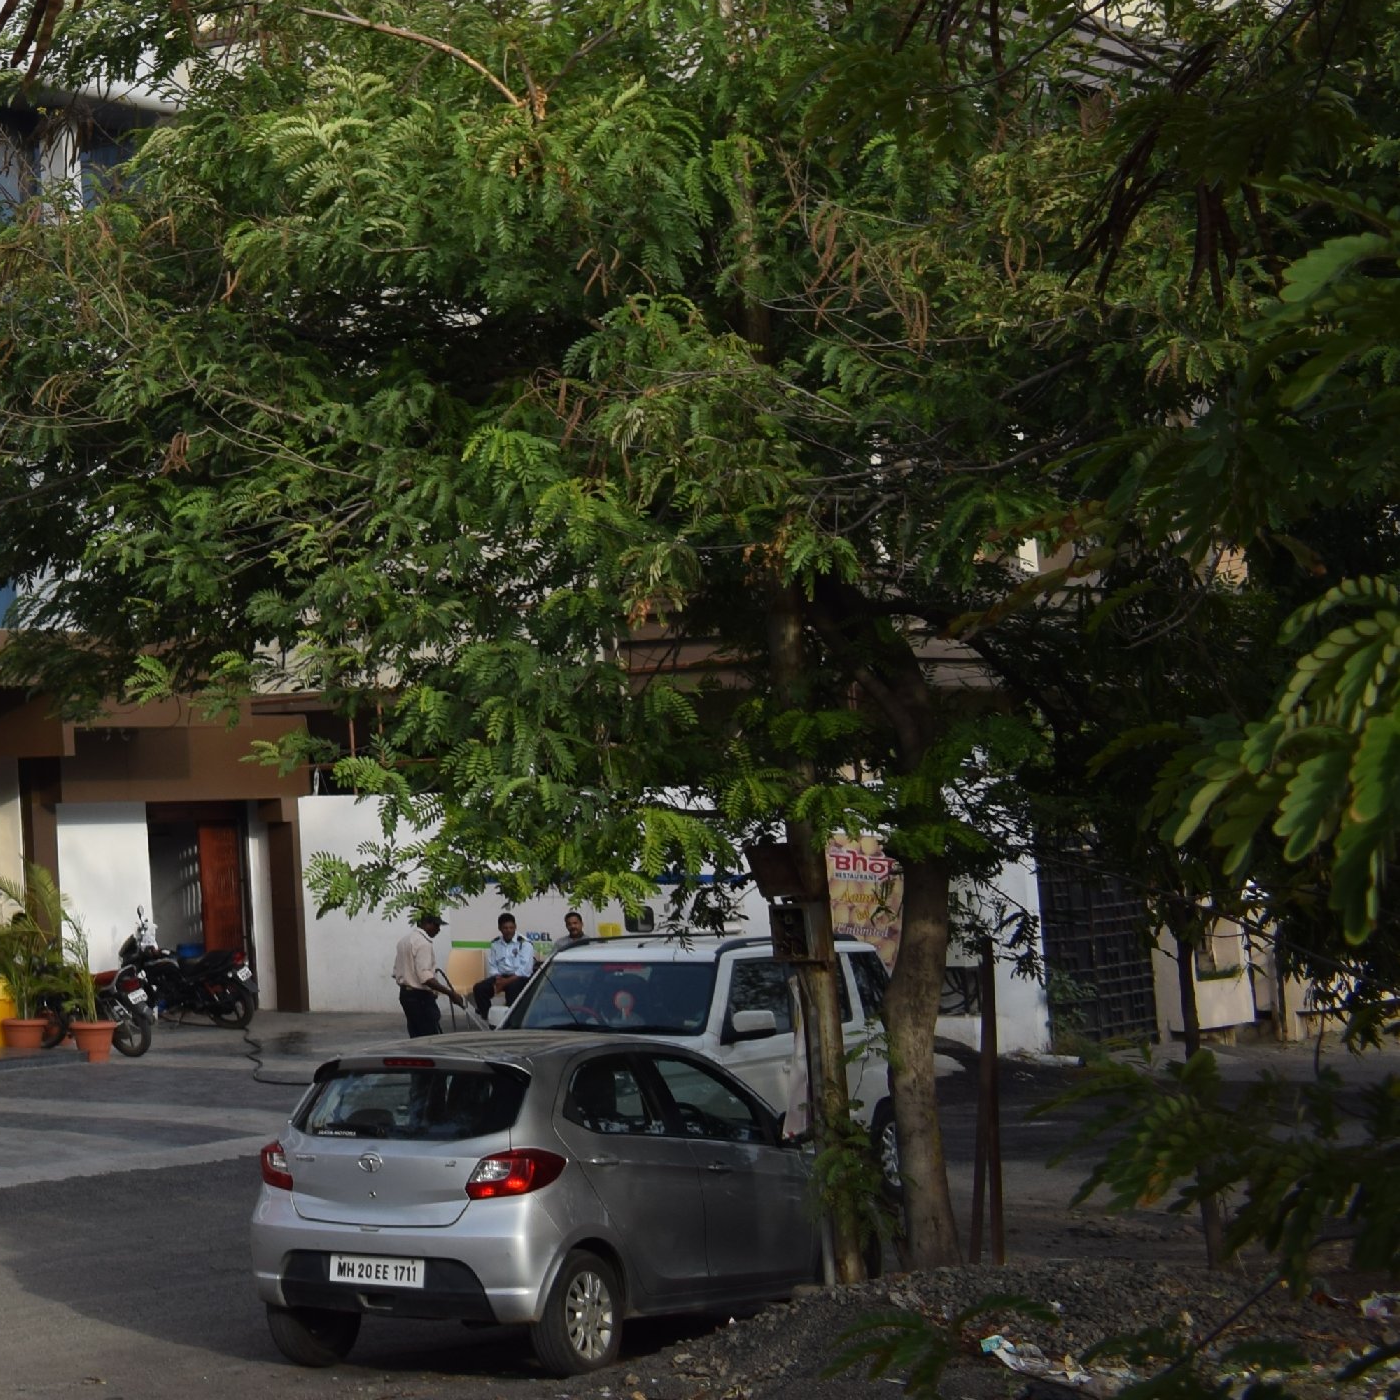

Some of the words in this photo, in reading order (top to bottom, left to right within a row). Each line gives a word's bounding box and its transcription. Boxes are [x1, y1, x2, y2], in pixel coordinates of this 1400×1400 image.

[337, 1261, 355, 1278] MH
[357, 1262, 372, 1279] 20
[375, 1264, 389, 1280] EE
[394, 1264, 417, 1282] 1711
